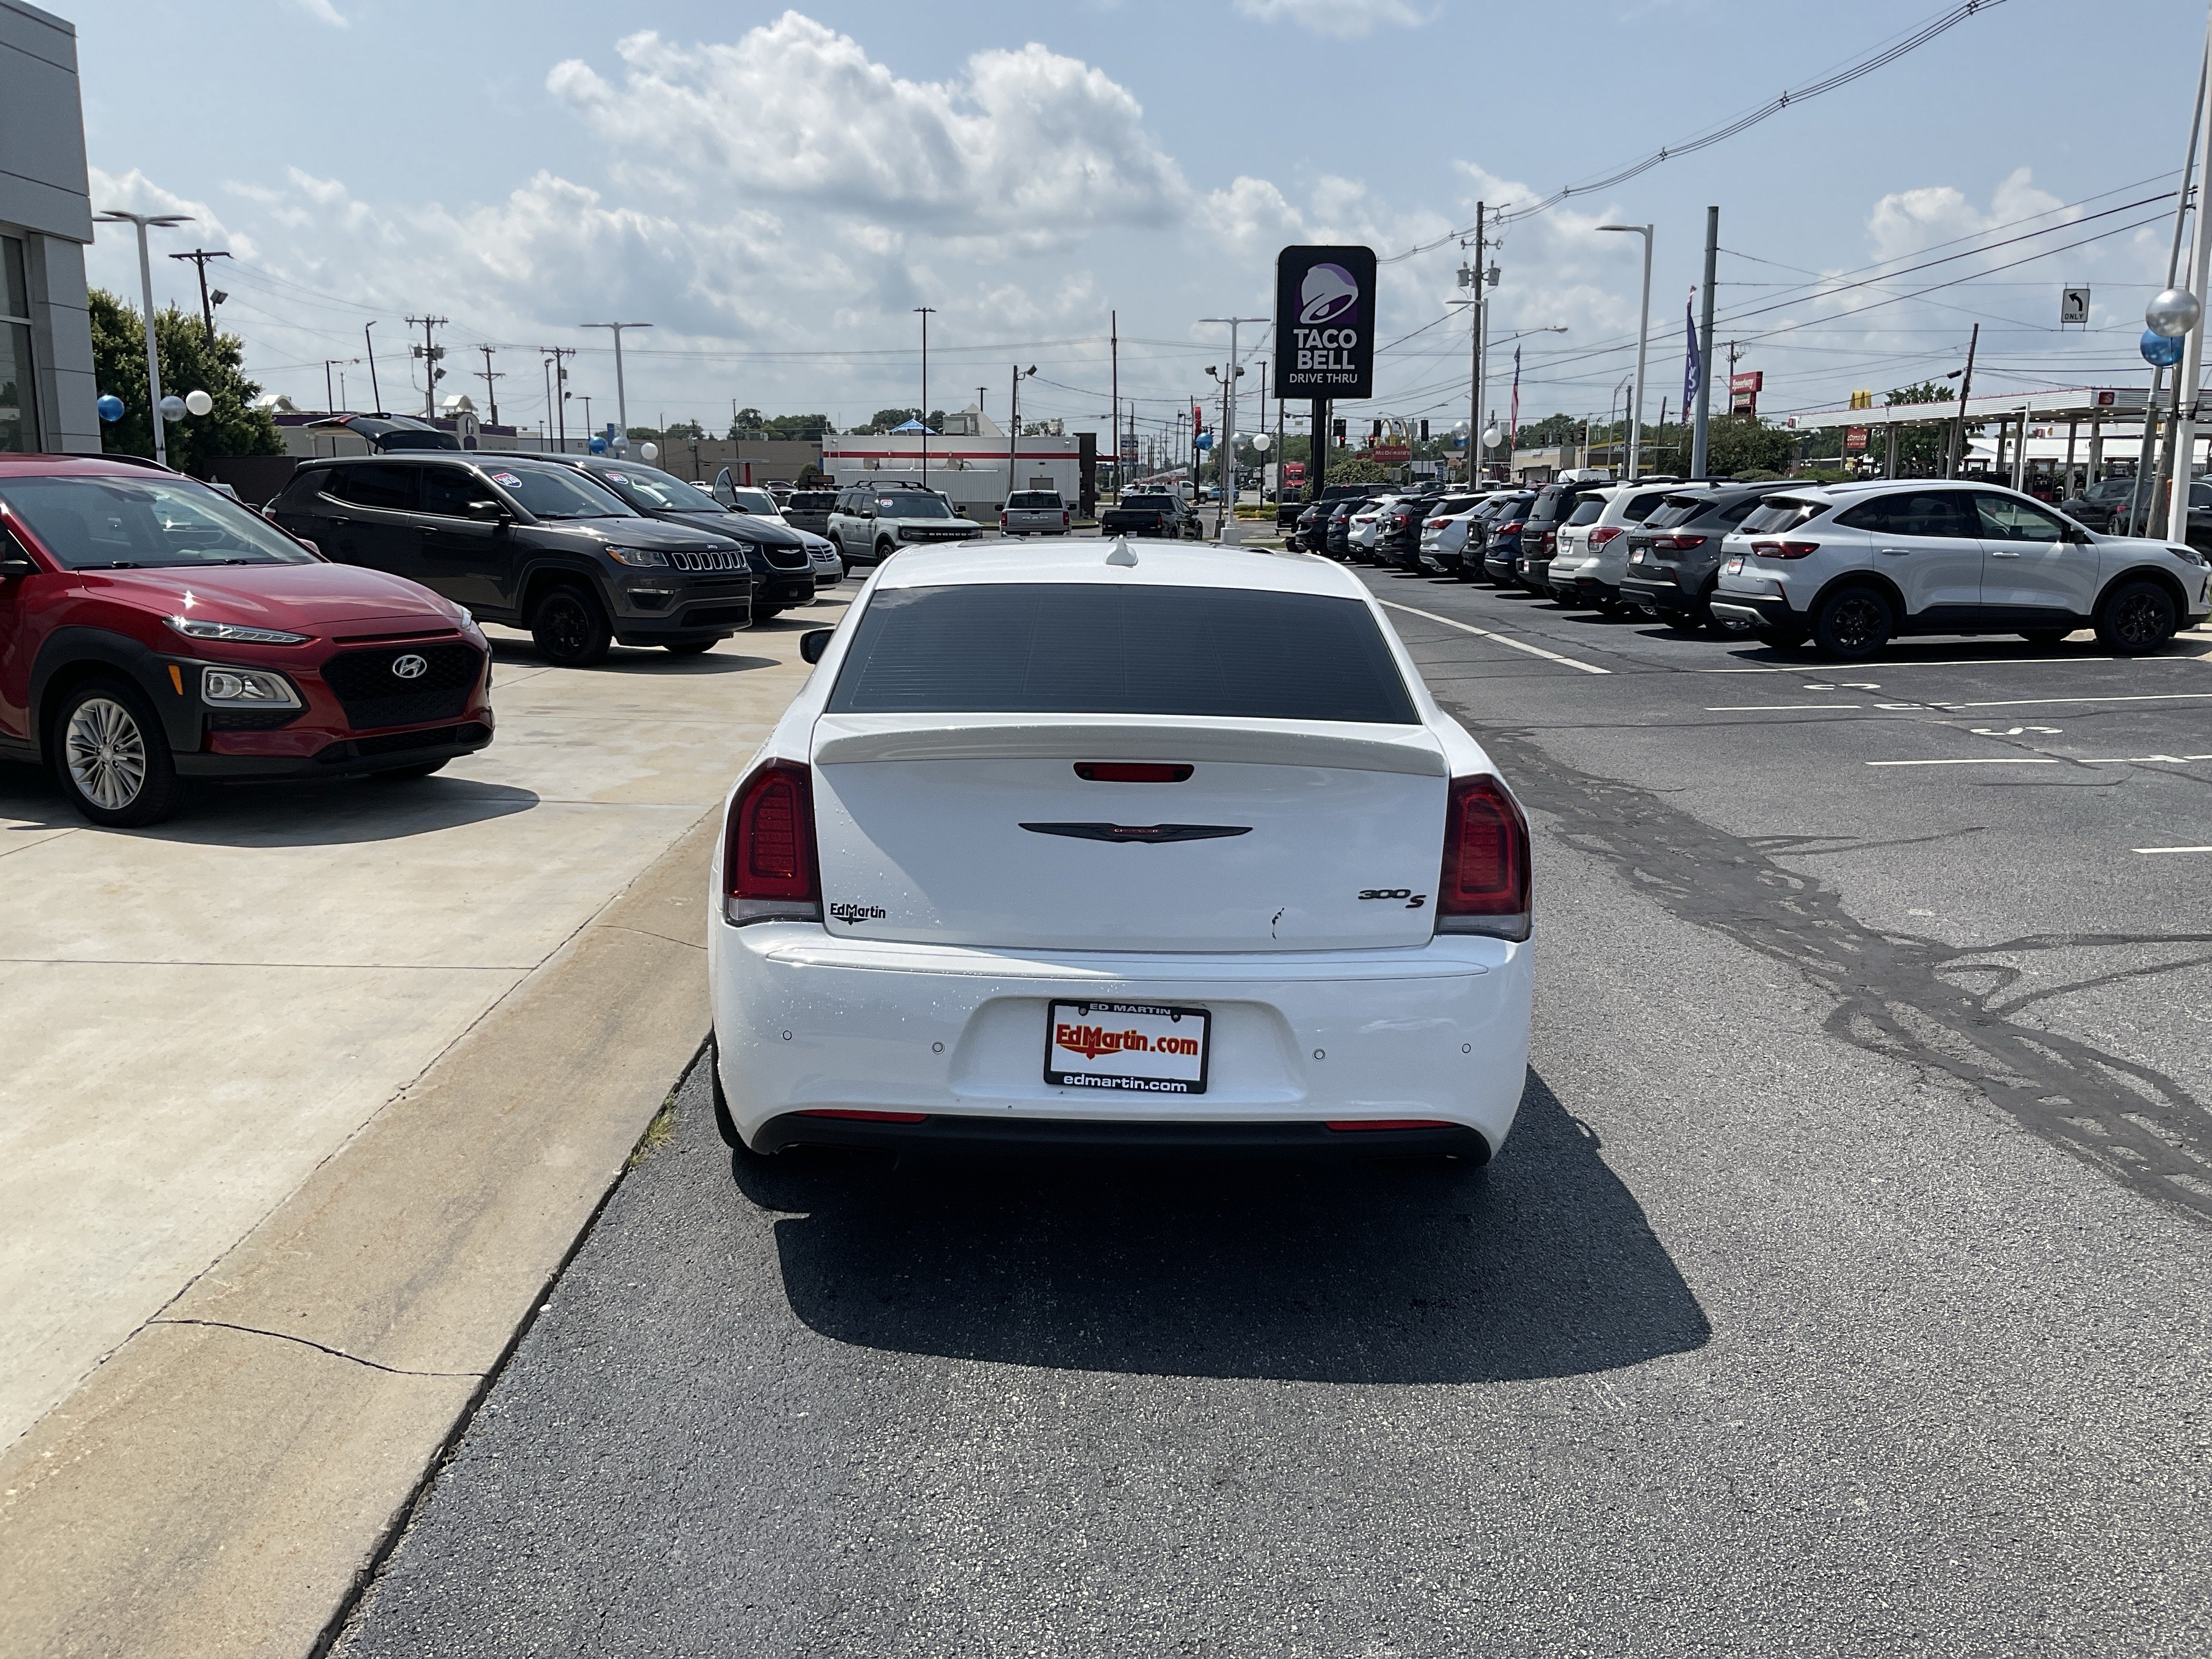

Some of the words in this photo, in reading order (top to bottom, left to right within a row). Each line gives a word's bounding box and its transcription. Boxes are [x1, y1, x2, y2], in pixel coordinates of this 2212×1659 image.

[1293, 329, 1357, 348] TACO
[1297, 350, 1355, 370] BELL
[1289, 373, 1323, 383] DRIVE
[1326, 373, 1358, 383] THRU
[1114, 1005, 1171, 1015] MARTIN
[1063, 1074, 1187, 1092] edmartin.com
